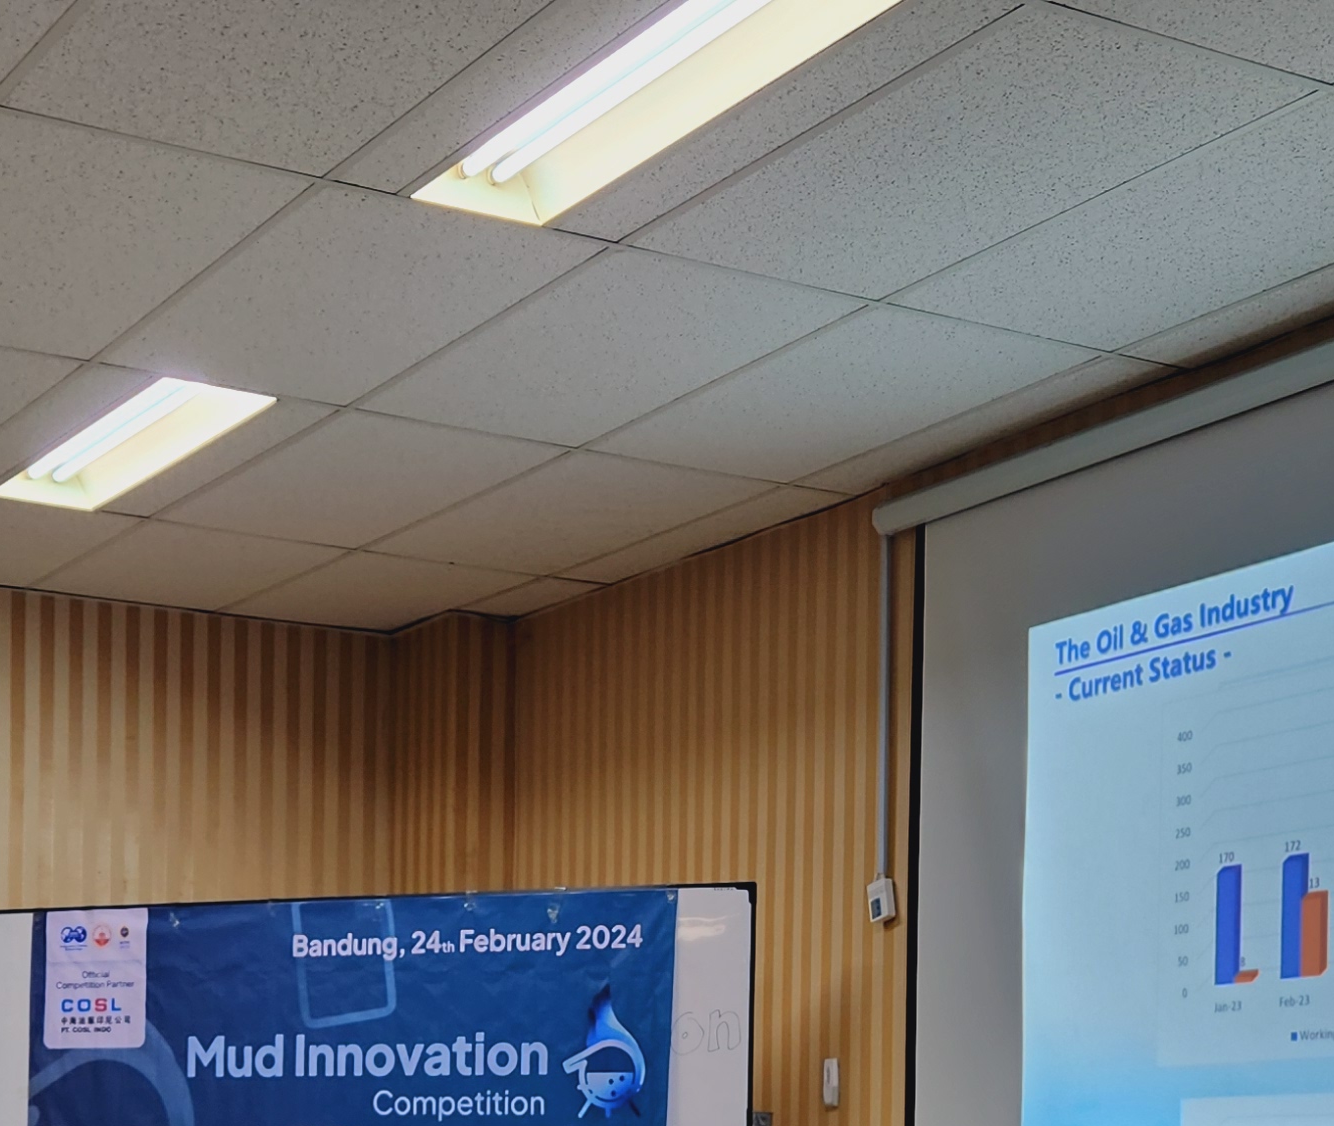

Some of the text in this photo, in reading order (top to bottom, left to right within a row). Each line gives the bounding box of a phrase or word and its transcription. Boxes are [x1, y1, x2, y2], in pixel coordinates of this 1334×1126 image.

[1055, 585, 1294, 665] The Oil & Gas Industry
[1069, 664, 1144, 701] Current
[1149, 649, 1216, 683] Status
[1177, 730, 1193, 742] 400
[1177, 762, 1192, 775] 350
[1175, 827, 1191, 839] 250
[1285, 840, 1301, 852] 172
[1219, 852, 1235, 864] 170
[292, 924, 643, 961] Bandung, 24th February 2024
[56, 980, 134, 990] Competition Partner
[61, 998, 122, 1013] COSL
[1214, 1001, 1242, 1013] Jan-23
[1279, 995, 1310, 1007] Feb-23
[186, 1032, 549, 1078] Mud Innovation
[372, 1089, 545, 1122] Competition
